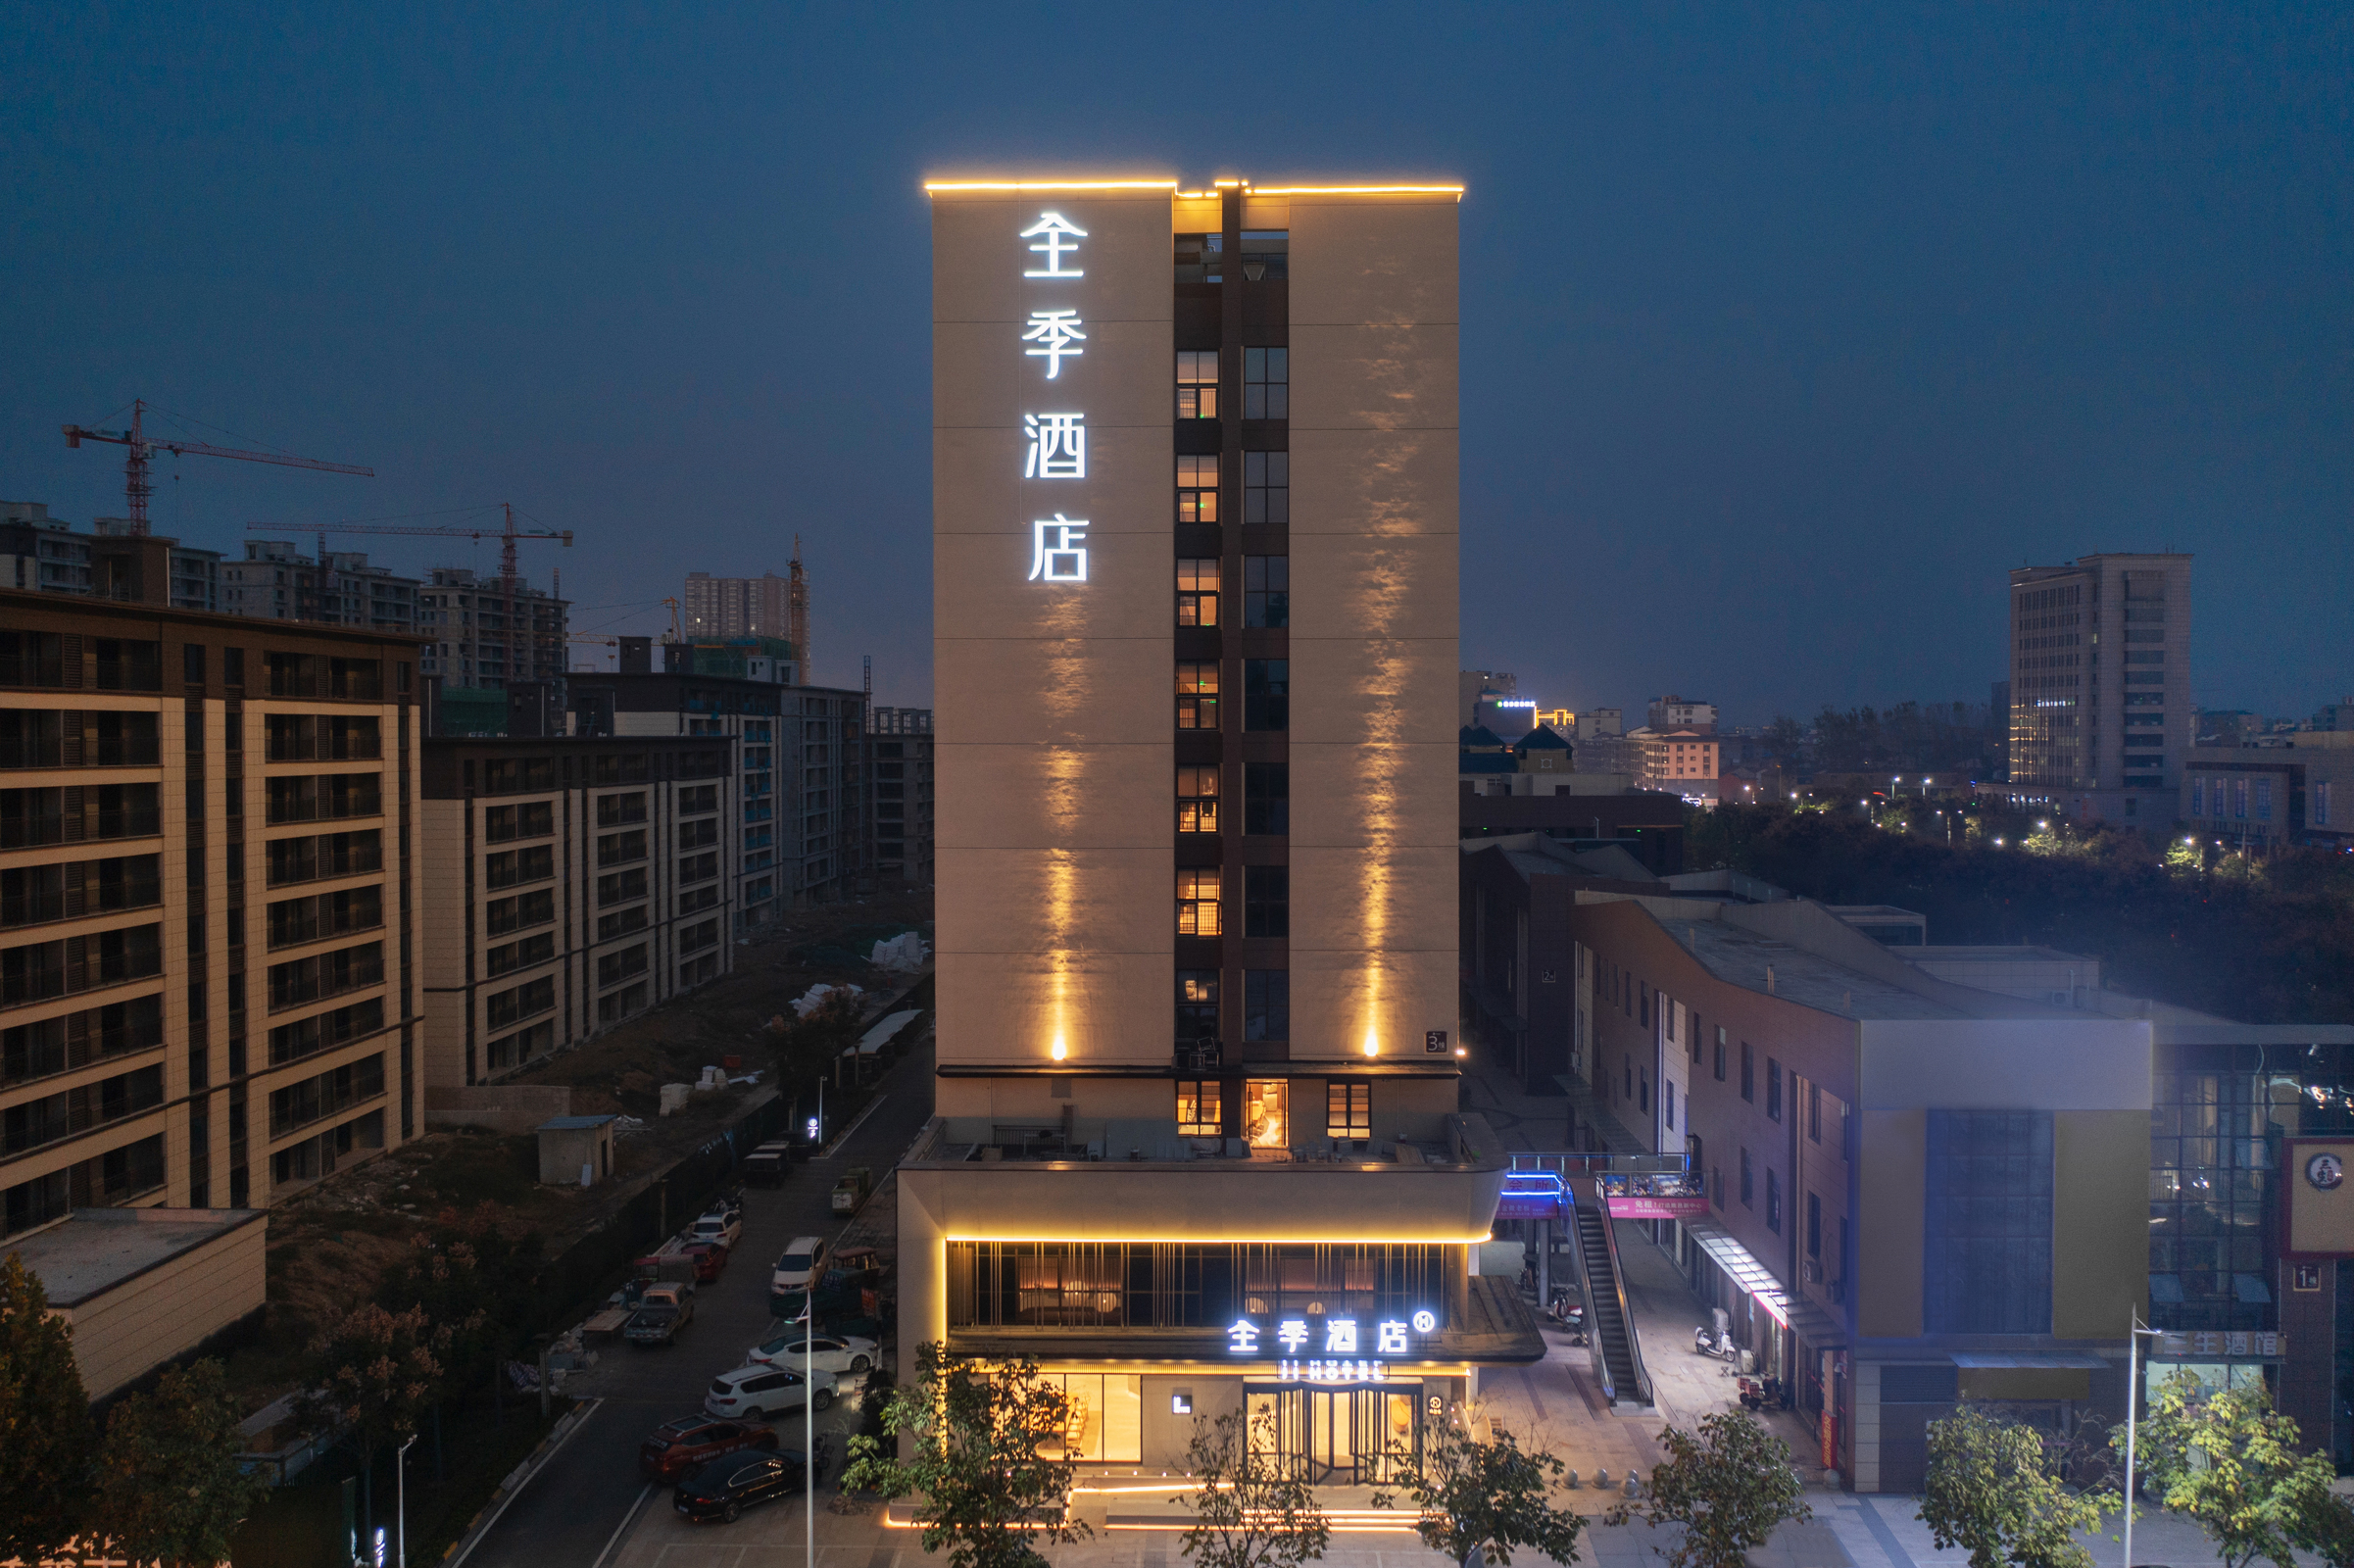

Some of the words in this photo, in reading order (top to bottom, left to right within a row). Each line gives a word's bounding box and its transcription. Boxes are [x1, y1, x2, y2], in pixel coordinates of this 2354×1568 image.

[1020, 213, 1090, 581] 全季酒店
[1227, 1319, 1408, 1353] 全季酒店
[2163, 1332, 2278, 1355] 三生酒馆
[1309, 1367, 1385, 1380] HOTEL
